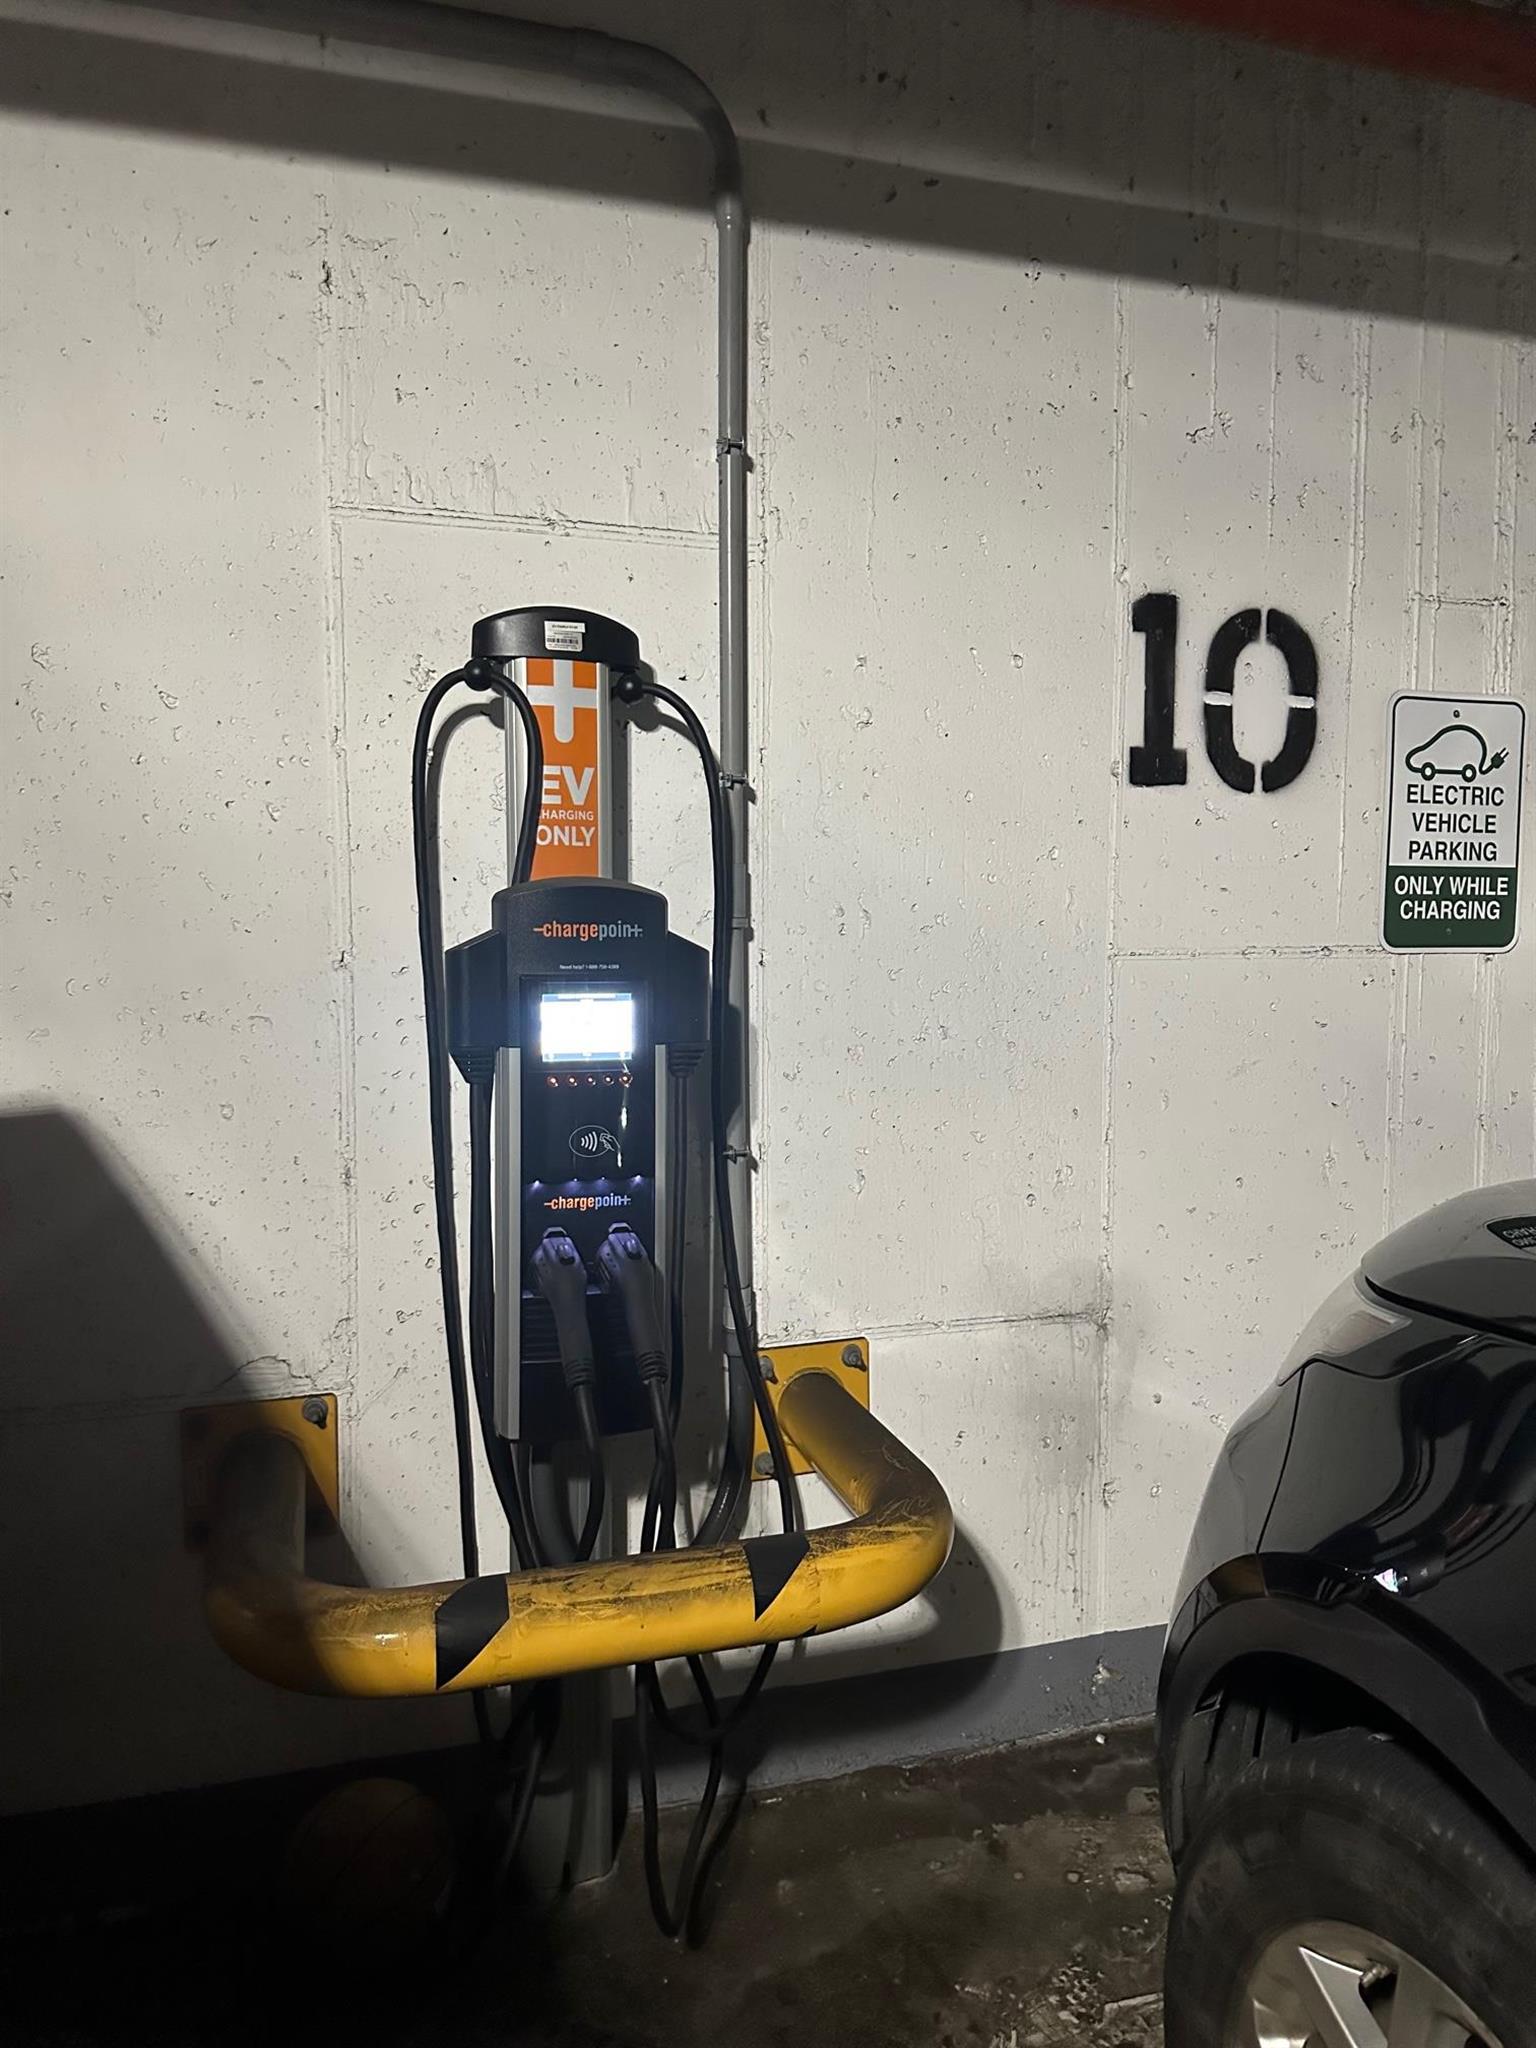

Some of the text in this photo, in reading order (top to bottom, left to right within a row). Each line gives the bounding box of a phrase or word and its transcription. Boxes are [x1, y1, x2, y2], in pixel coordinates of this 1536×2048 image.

[1129, 592, 1318, 793] 10
[541, 764, 595, 806] EV
[1406, 784, 1504, 806] ELECTRIC
[540, 808, 594, 821] HARGING
[1412, 812, 1497, 834] VEHICLE
[536, 824, 596, 847] ONLY
[1408, 840, 1498, 862] PARKING
[1394, 875, 1509, 897] ONLY WHILE
[1399, 899, 1501, 920] CHARGING
